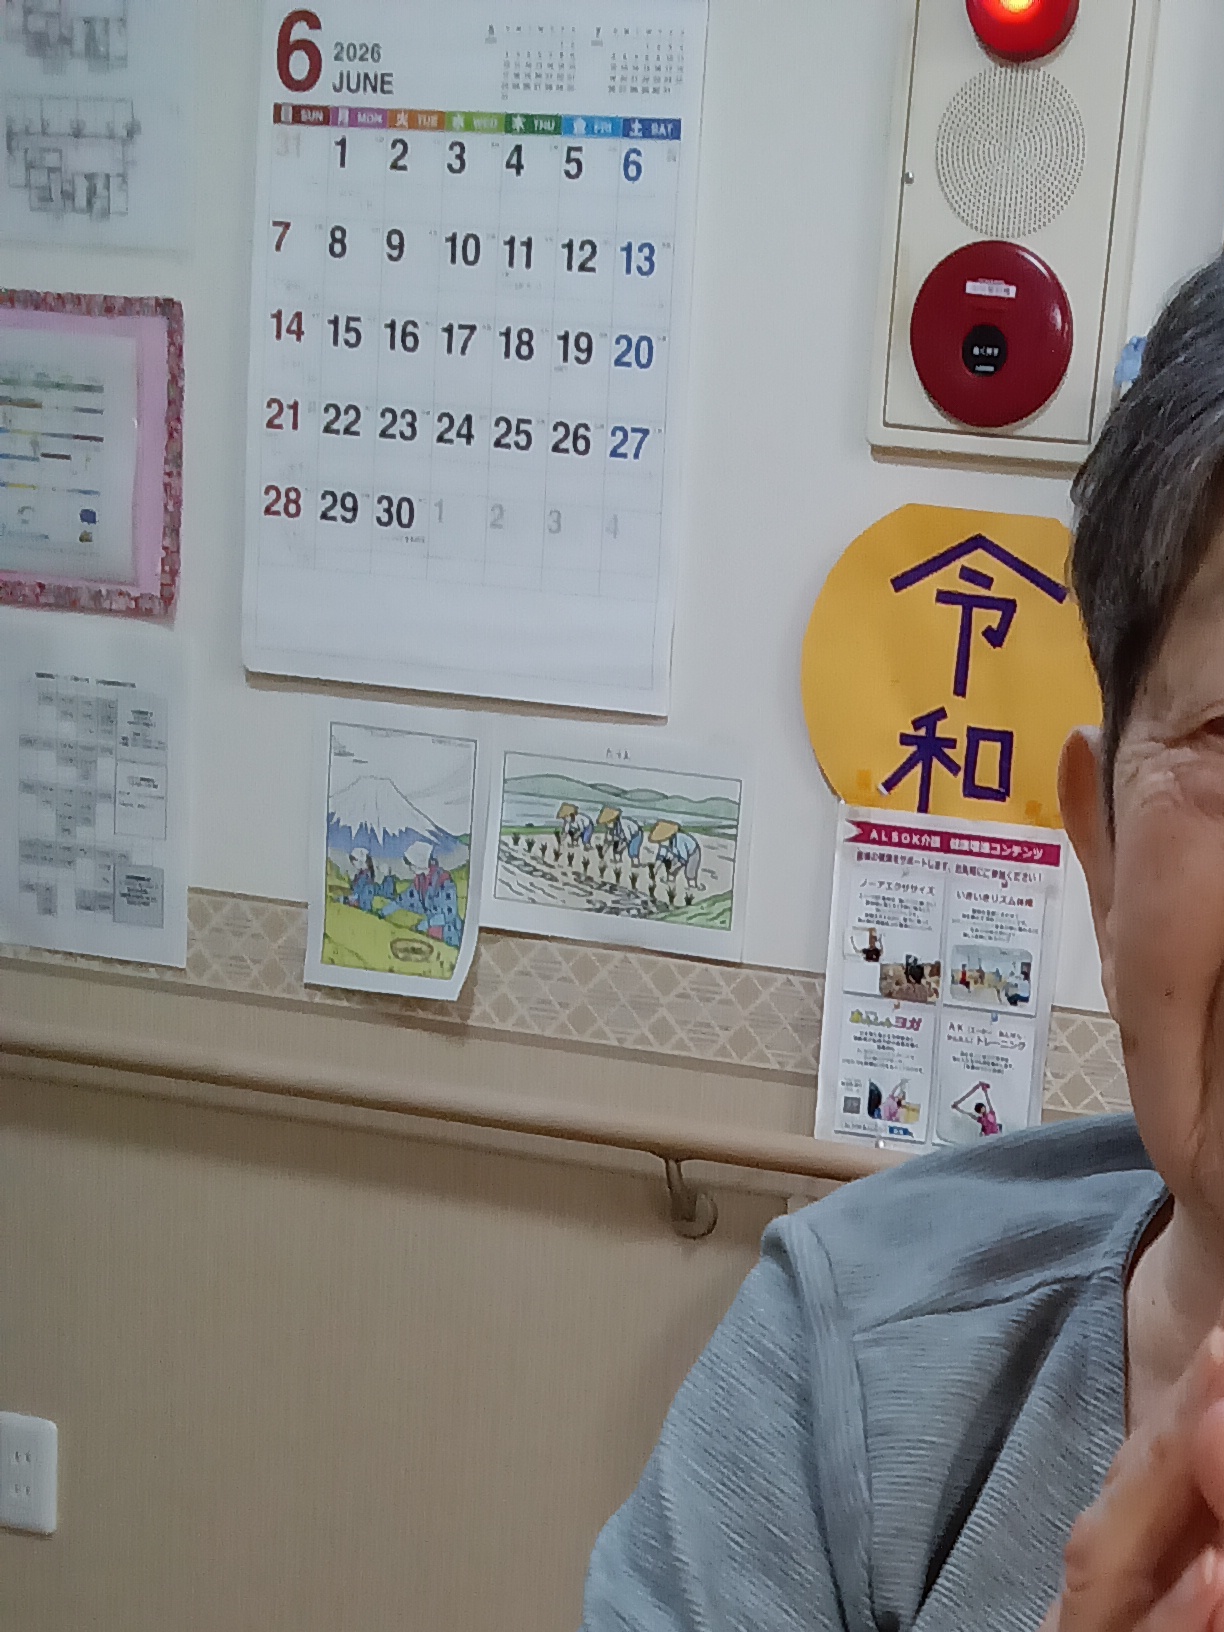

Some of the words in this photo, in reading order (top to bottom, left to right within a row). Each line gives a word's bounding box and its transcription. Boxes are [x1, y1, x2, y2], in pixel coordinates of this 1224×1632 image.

[276, 8, 323, 93] 6
[333, 41, 382, 64] 2026
[332, 69, 394, 95] JUNE
[300, 110, 324, 122] SUN
[357, 111, 383, 123] MON
[418, 114, 438, 126] TUE
[534, 118, 556, 131] THU
[594, 120, 612, 133] FRI
[629, 119, 643, 137] 土
[651, 123, 673, 136] SAT
[334, 135, 347, 169] 1
[389, 138, 409, 172] 2
[446, 140, 466, 174] 3
[505, 143, 525, 177] 4
[563, 145, 583, 180] 5
[622, 147, 643, 183] 6
[271, 220, 292, 253] 7
[328, 225, 347, 259] 8
[385, 228, 405, 262] 9
[444, 231, 481, 267] 10
[503, 234, 533, 270] 11
[561, 238, 598, 274] 12
[619, 241, 656, 277] 13
[270, 308, 305, 343] 14
[327, 314, 362, 349] 15
[383, 318, 420, 353] 16
[440, 322, 478, 356] 17
[498, 325, 535, 362] 18
[556, 329, 594, 366] 19
[613, 334, 654, 370] 20
[265, 397, 299, 431] 21
[322, 402, 362, 437] 22
[378, 406, 418, 442] 23
[435, 411, 475, 446] 24
[493, 415, 533, 451] 25
[551, 420, 591, 457] 26
[608, 425, 650, 460] 27
[263, 484, 302, 519] 28
[319, 489, 359, 524] 29
[375, 494, 415, 529] 30
[433, 498, 444, 524] 1
[489, 503, 505, 530] 2
[548, 509, 562, 534] 3
[888, 532, 1068, 814] 令和
